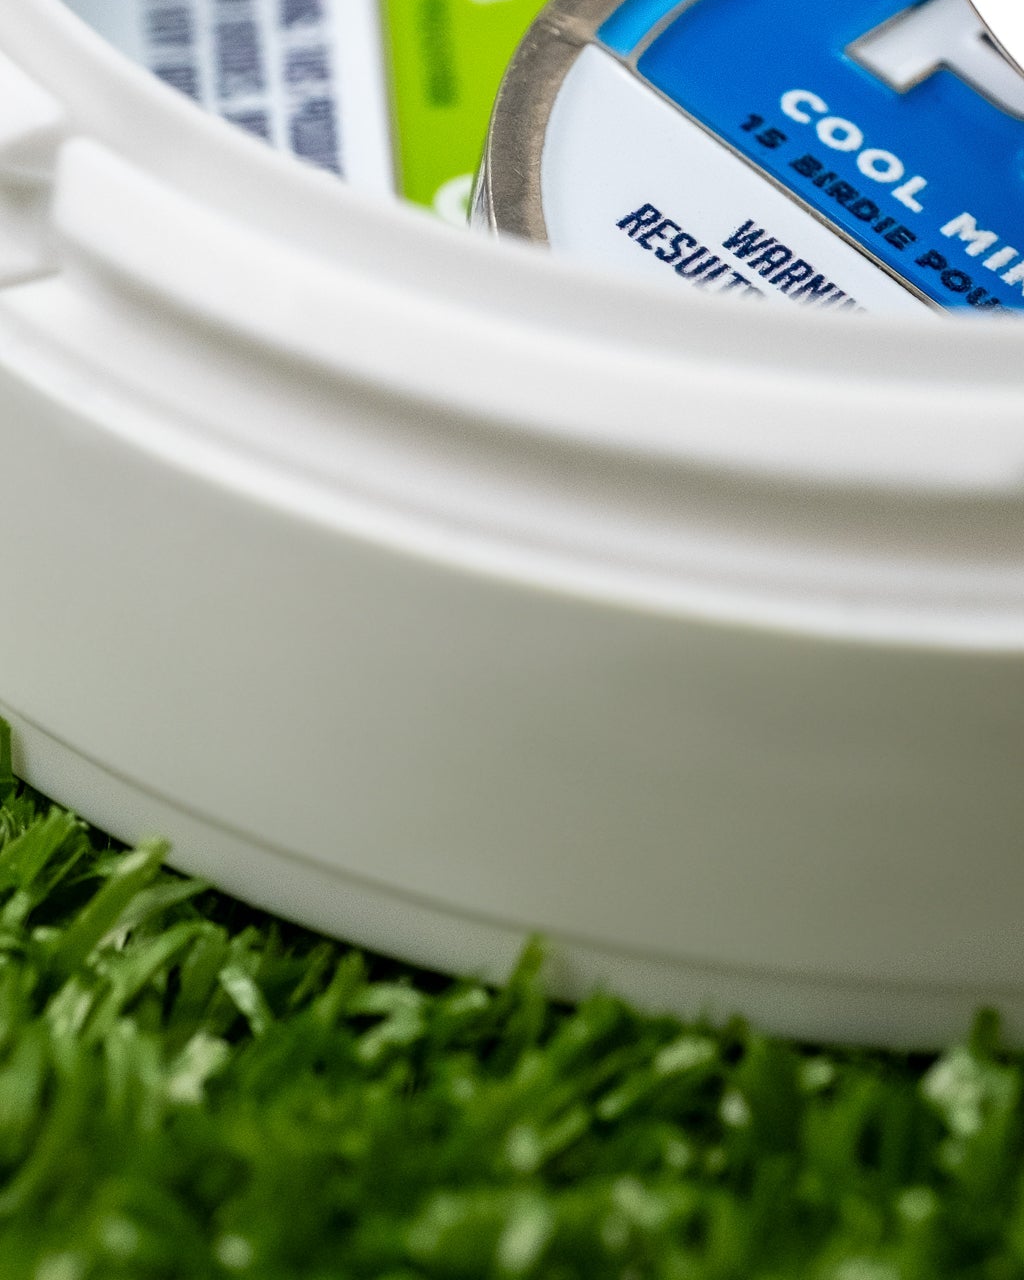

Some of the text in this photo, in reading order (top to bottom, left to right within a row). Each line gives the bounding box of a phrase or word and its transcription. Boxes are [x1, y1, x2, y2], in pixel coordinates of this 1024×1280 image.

[740, 113, 789, 151] 15
[788, 153, 918, 252] BIRDIE
[780, 89, 928, 214] COOL
[615, 202, 766, 302] RESULT
